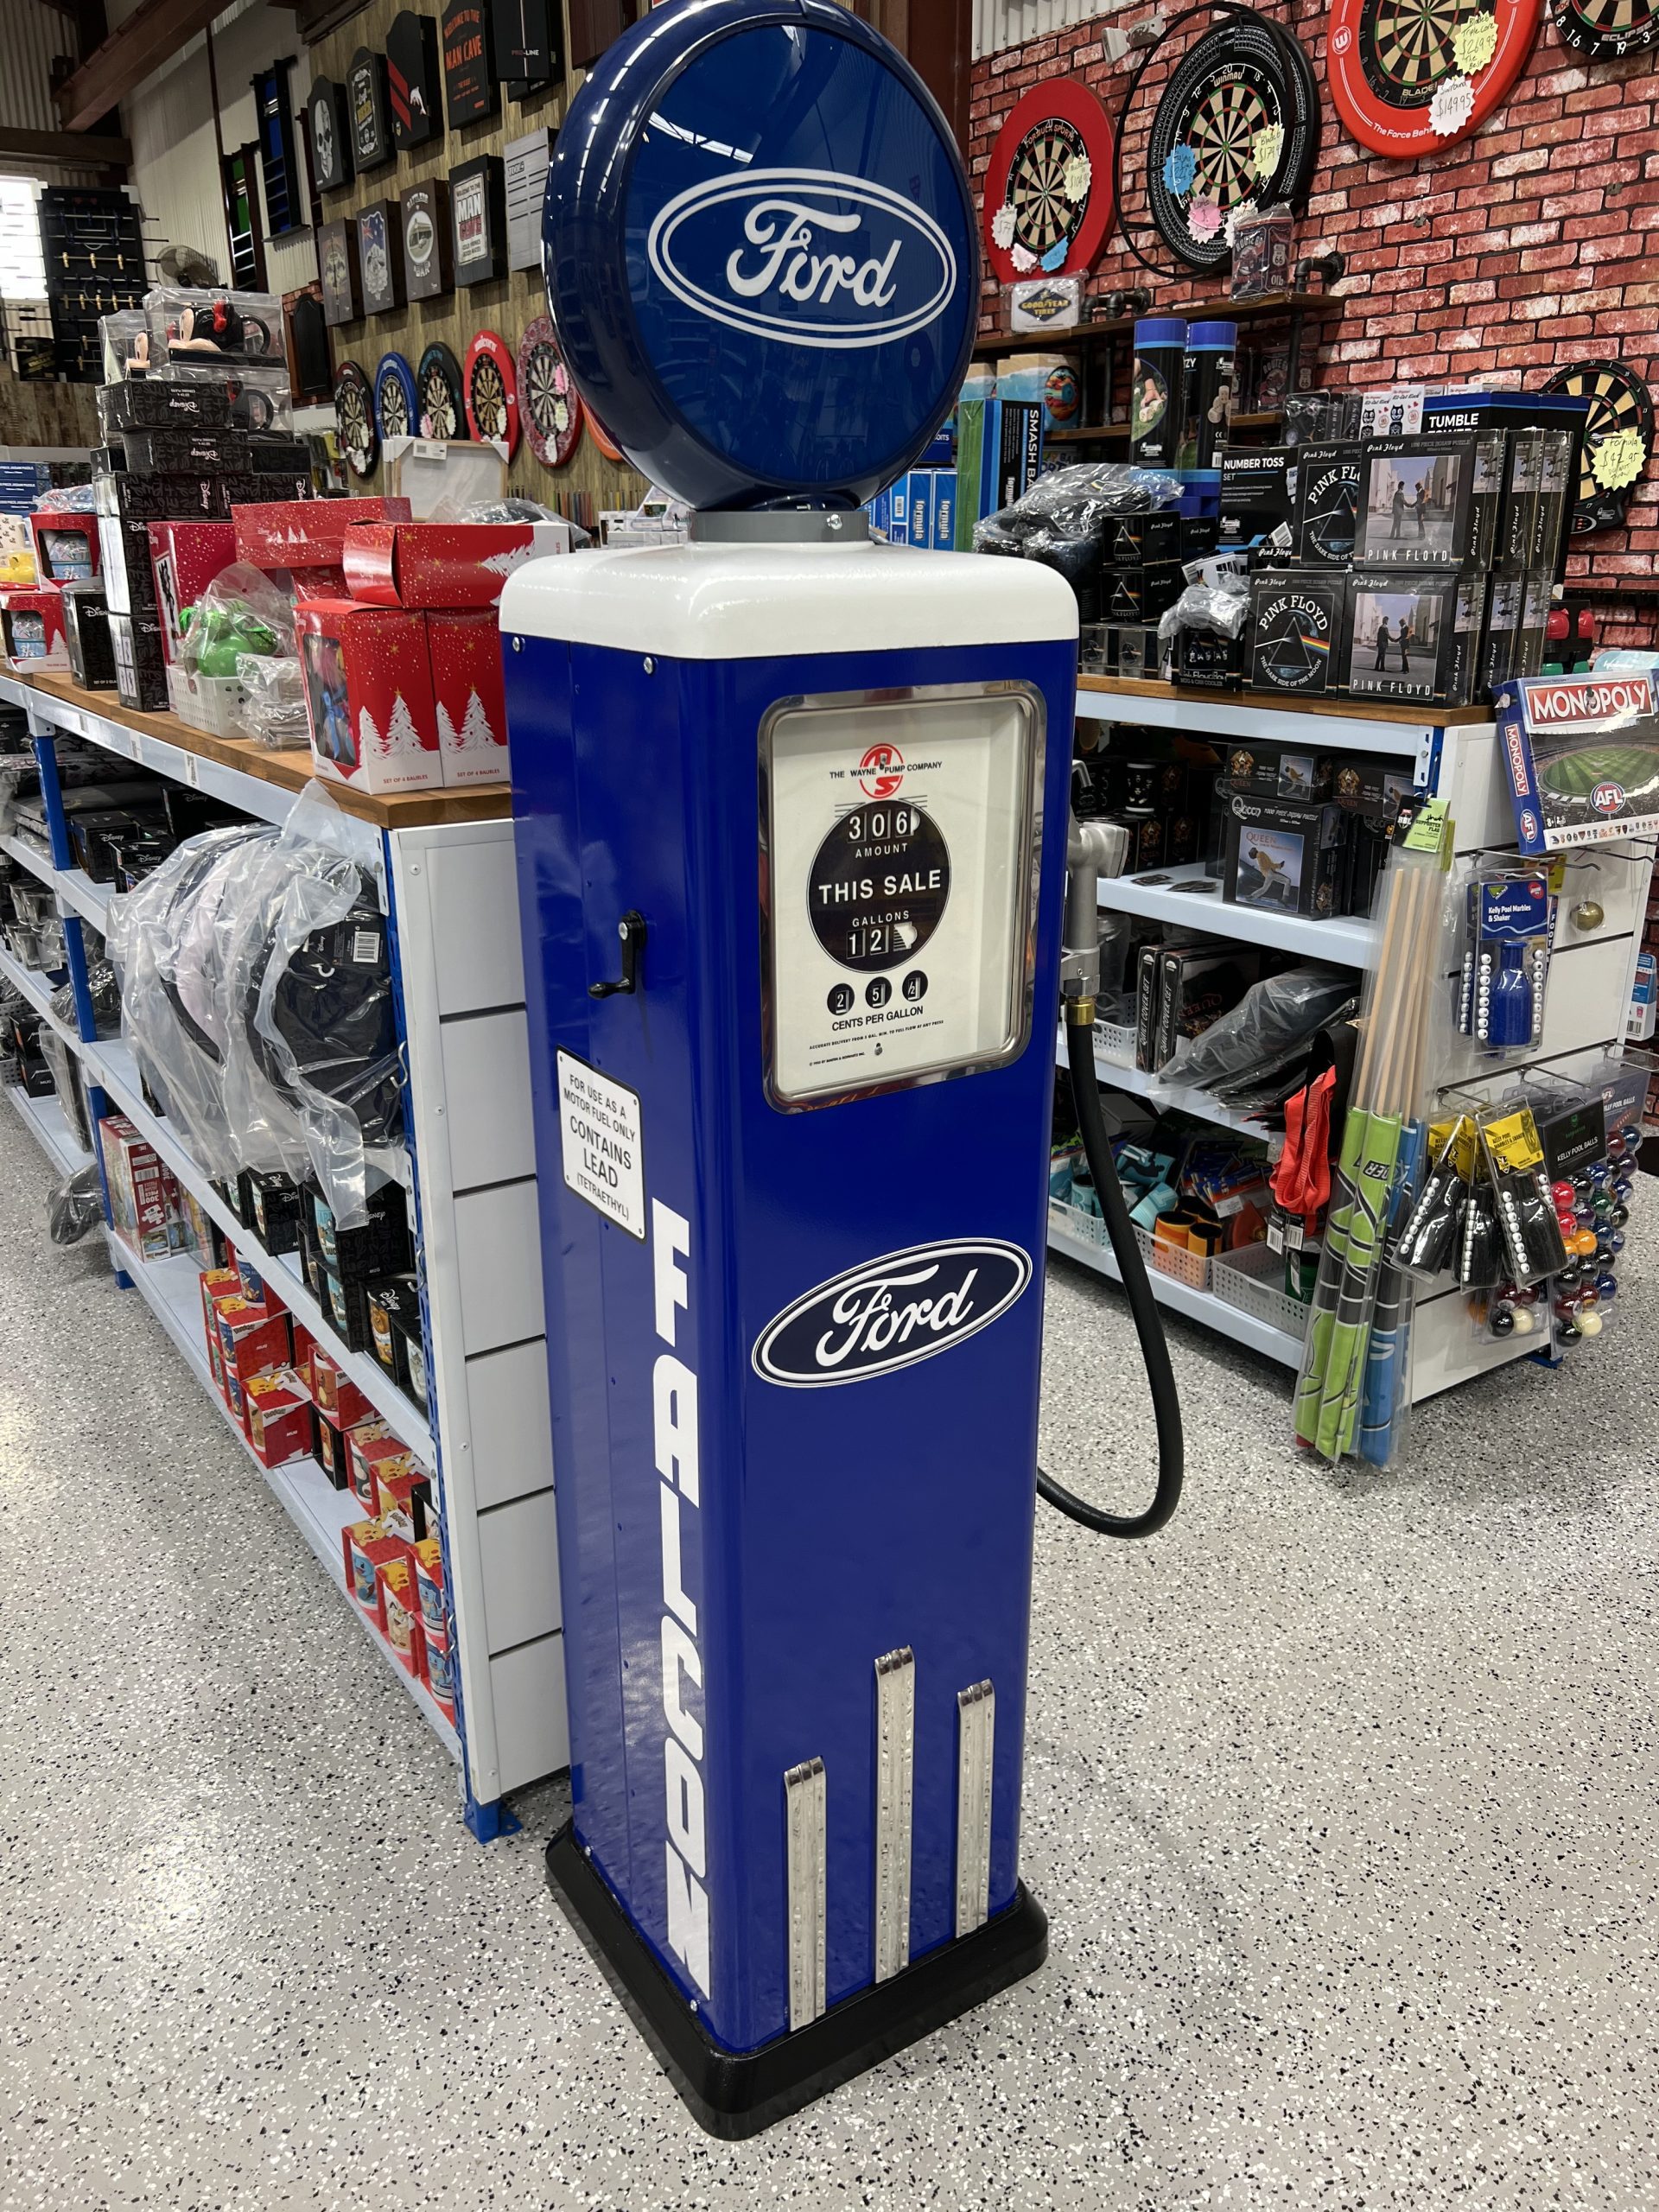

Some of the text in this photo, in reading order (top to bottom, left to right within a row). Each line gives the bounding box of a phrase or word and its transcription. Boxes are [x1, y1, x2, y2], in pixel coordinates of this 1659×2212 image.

[1601, 21, 1653, 41] ECLIPSE
[1213, 71, 1243, 87] WINMAU
[1372, 123, 1387, 134] The
[1386, 128, 1411, 139] Force
[457, 192, 481, 222] MAN
[725, 200, 902, 308] Ford
[1428, 413, 1479, 429] TUMBLE
[1027, 409, 1039, 464] SMASH
[1367, 444, 1382, 453] Pink
[1383, 443, 1404, 453] Floyd
[1224, 457, 1285, 470] NUMBER TOSS
[1303, 451, 1318, 460] Pink
[1318, 450, 1338, 460] Floyd
[1223, 473, 1236, 481] SET
[1307, 469, 1339, 505] PINK
[914, 499, 925, 540] formula
[939, 499, 950, 540] formula
[1367, 549, 1448, 562] PINK FLOYD
[1268, 578, 1287, 587] Floyd
[1368, 579, 1389, 588] Floyd
[1258, 595, 1329, 631] PINK FLOYD
[1264, 664, 1278, 683] DARK
[1277, 677, 1290, 687] SIDE
[1289, 678, 1298, 687] OF
[1297, 674, 1309, 686] THE
[1308, 658, 1323, 680] MOON
[1352, 679, 1431, 696] PINK FLOYD
[1532, 683, 1647, 721] MONOPOLY
[830, 761, 943, 779] THE WAYNE PUMP COMPANY
[1506, 728, 1529, 795] MONOPOLY
[182, 793, 208, 802] Disney
[1594, 791, 1624, 807] AFL
[99, 834, 124, 842] Disney
[1521, 812, 1535, 841] AFL
[136, 854, 162, 862] Disney
[855, 842, 908, 858] AMOUNT
[818, 869, 942, 905] THIS SALE
[852, 910, 910, 928] GALLONS
[1488, 904, 1531, 915] Kelly Pool Marbles
[831, 1005, 924, 1031] CENTS PER GALLON
[1140, 1020, 1148, 1046] QUILT
[569, 1074, 626, 1120] FOR USE AS A
[1623, 1096, 1636, 1106] BALLS
[563, 1087, 636, 1143] MOTOR FUEL ONLY
[569, 1115, 632, 1170] CONTAINS
[1557, 1136, 1599, 1162] KELLY POOL BALLS
[583, 1147, 619, 1189] LEAD
[576, 1172, 630, 1221] (TETRAETHYL)
[816, 1264, 979, 1368] Ford
[650, 1196, 713, 2000] FALCON
